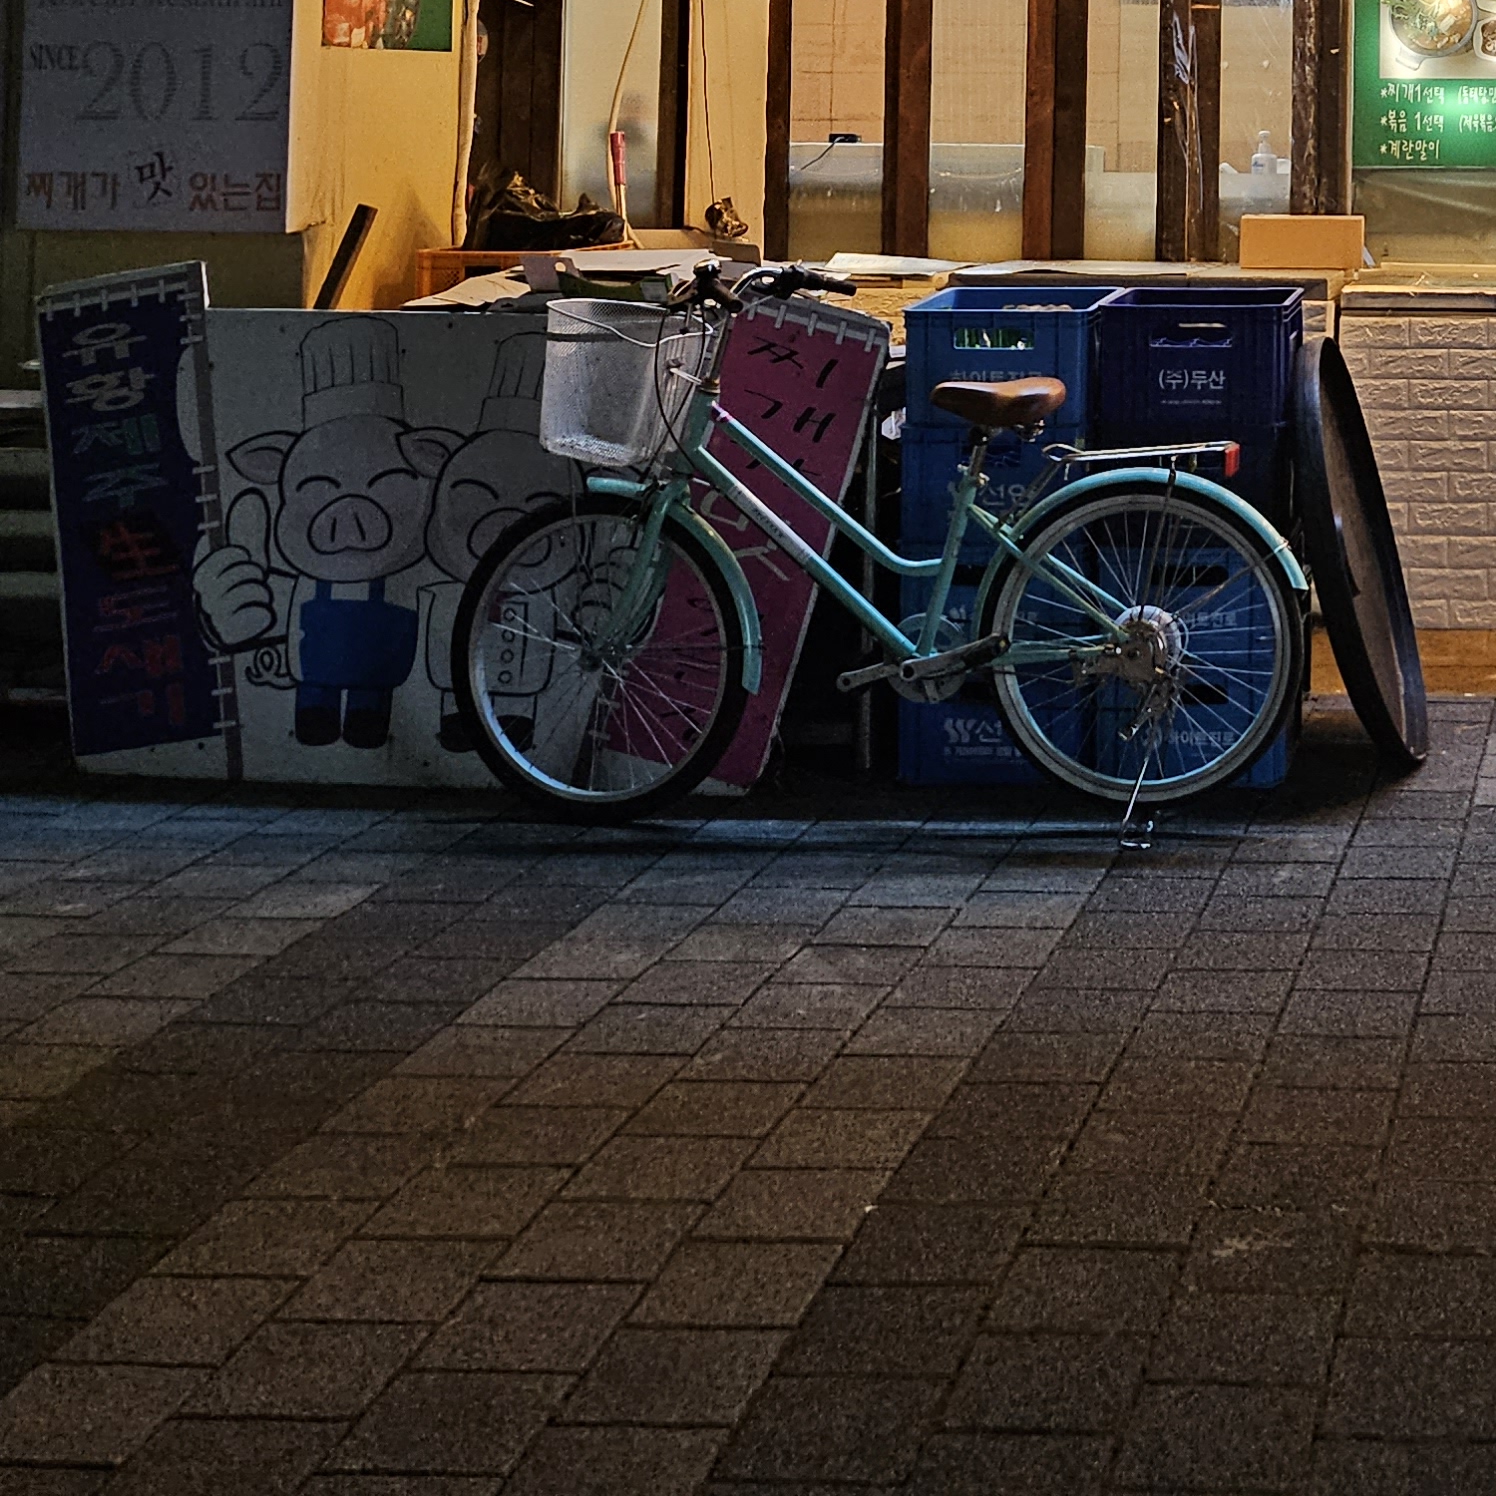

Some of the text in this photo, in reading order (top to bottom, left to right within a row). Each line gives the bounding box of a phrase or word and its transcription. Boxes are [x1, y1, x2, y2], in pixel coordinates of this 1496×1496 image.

[29, 40, 283, 122] SINCE 2012
[26, 171, 121, 211] 찌개가
[134, 151, 174, 202] 맛
